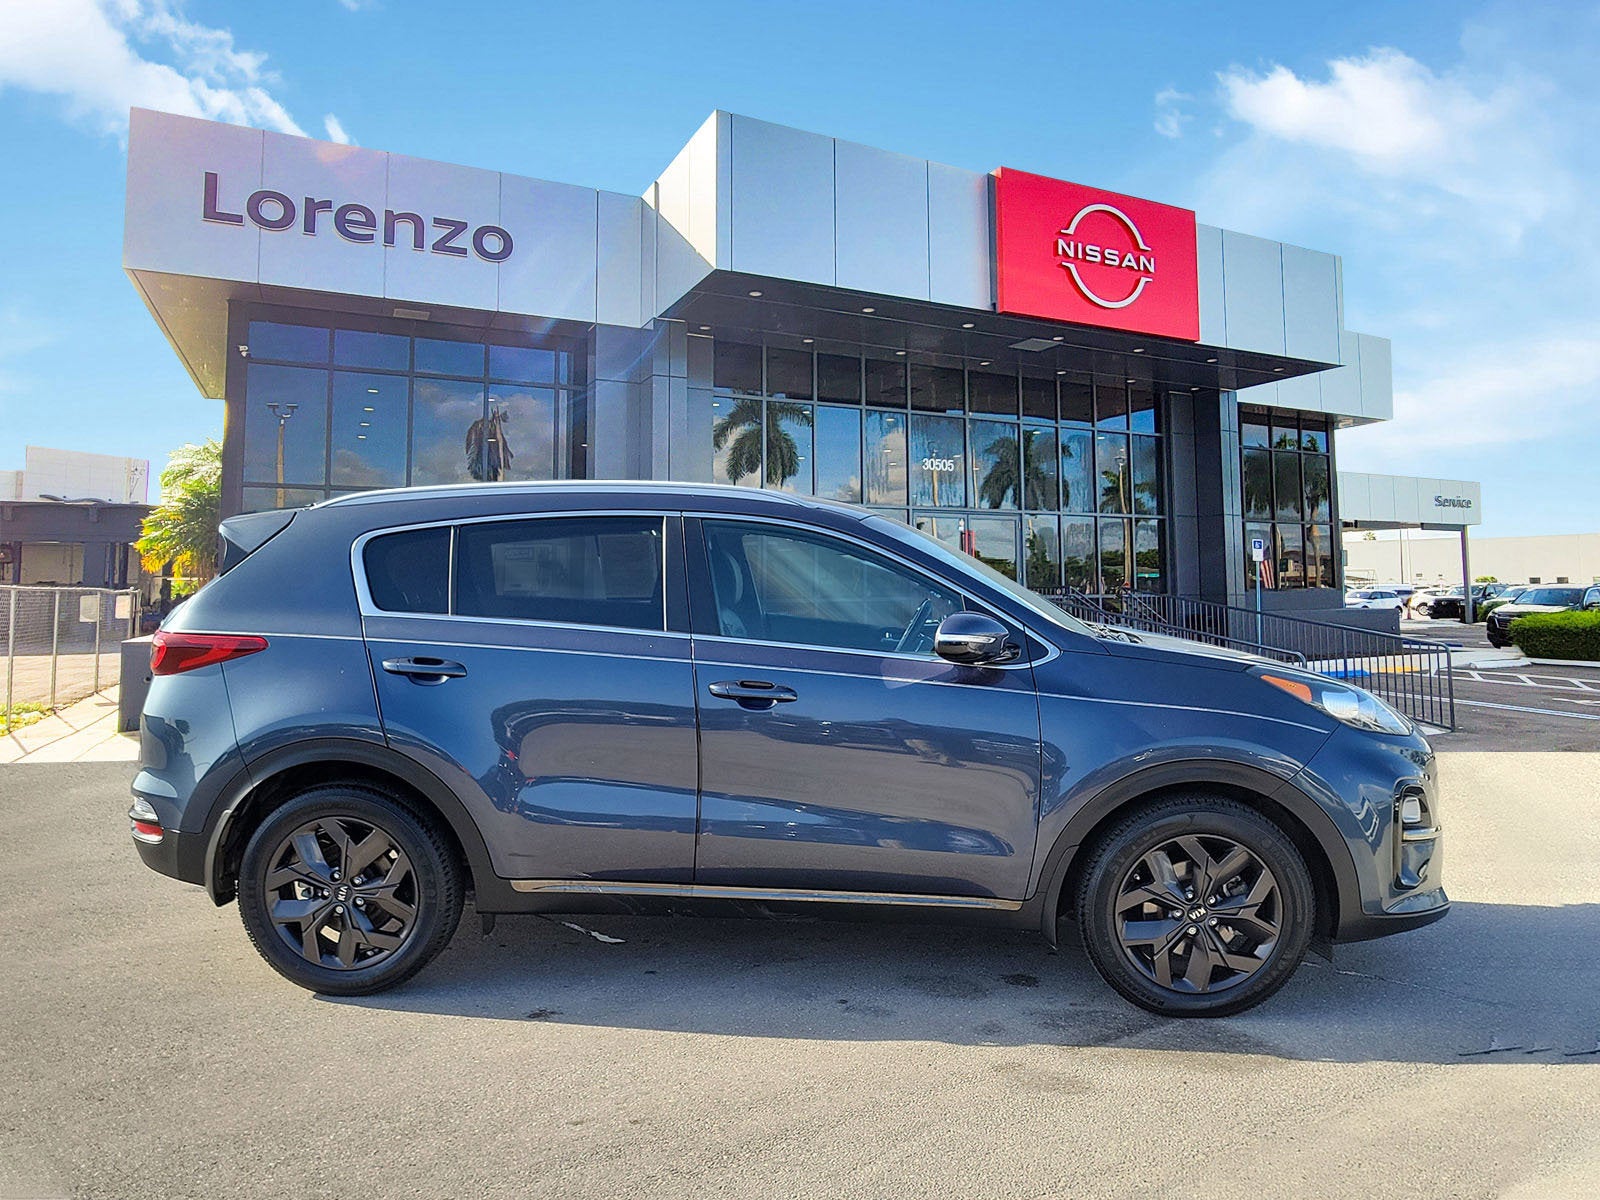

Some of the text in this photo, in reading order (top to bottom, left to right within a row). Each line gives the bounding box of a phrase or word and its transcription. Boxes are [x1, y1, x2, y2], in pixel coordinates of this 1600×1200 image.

[202, 171, 514, 262] Lorenzo
[1057, 238, 1155, 273] NISSAN
[922, 457, 954, 471] 30505
[1434, 495, 1472, 508] Service
